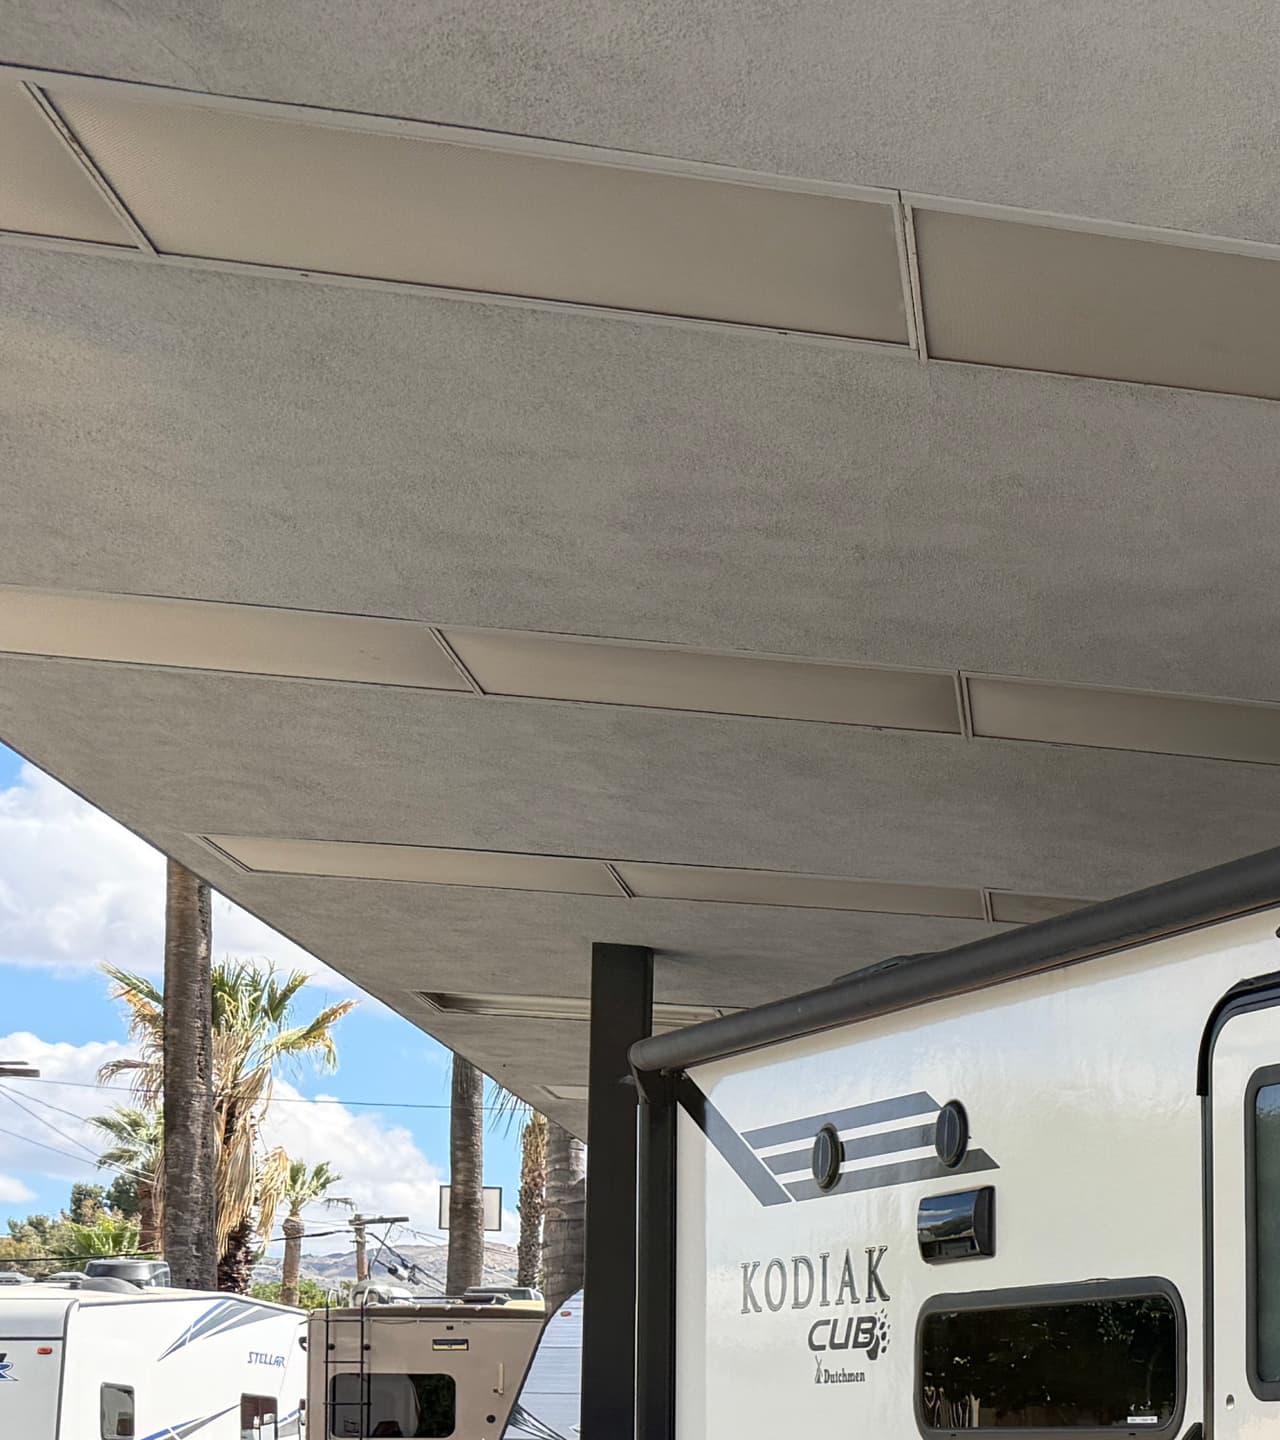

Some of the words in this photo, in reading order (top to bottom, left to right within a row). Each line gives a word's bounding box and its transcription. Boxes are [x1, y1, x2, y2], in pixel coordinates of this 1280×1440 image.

[740, 1244, 891, 1315] KODIAK
[807, 1315, 878, 1352] CUB
[247, 1351, 286, 1369] STELLAR
[823, 1367, 866, 1384] Dutchmen
